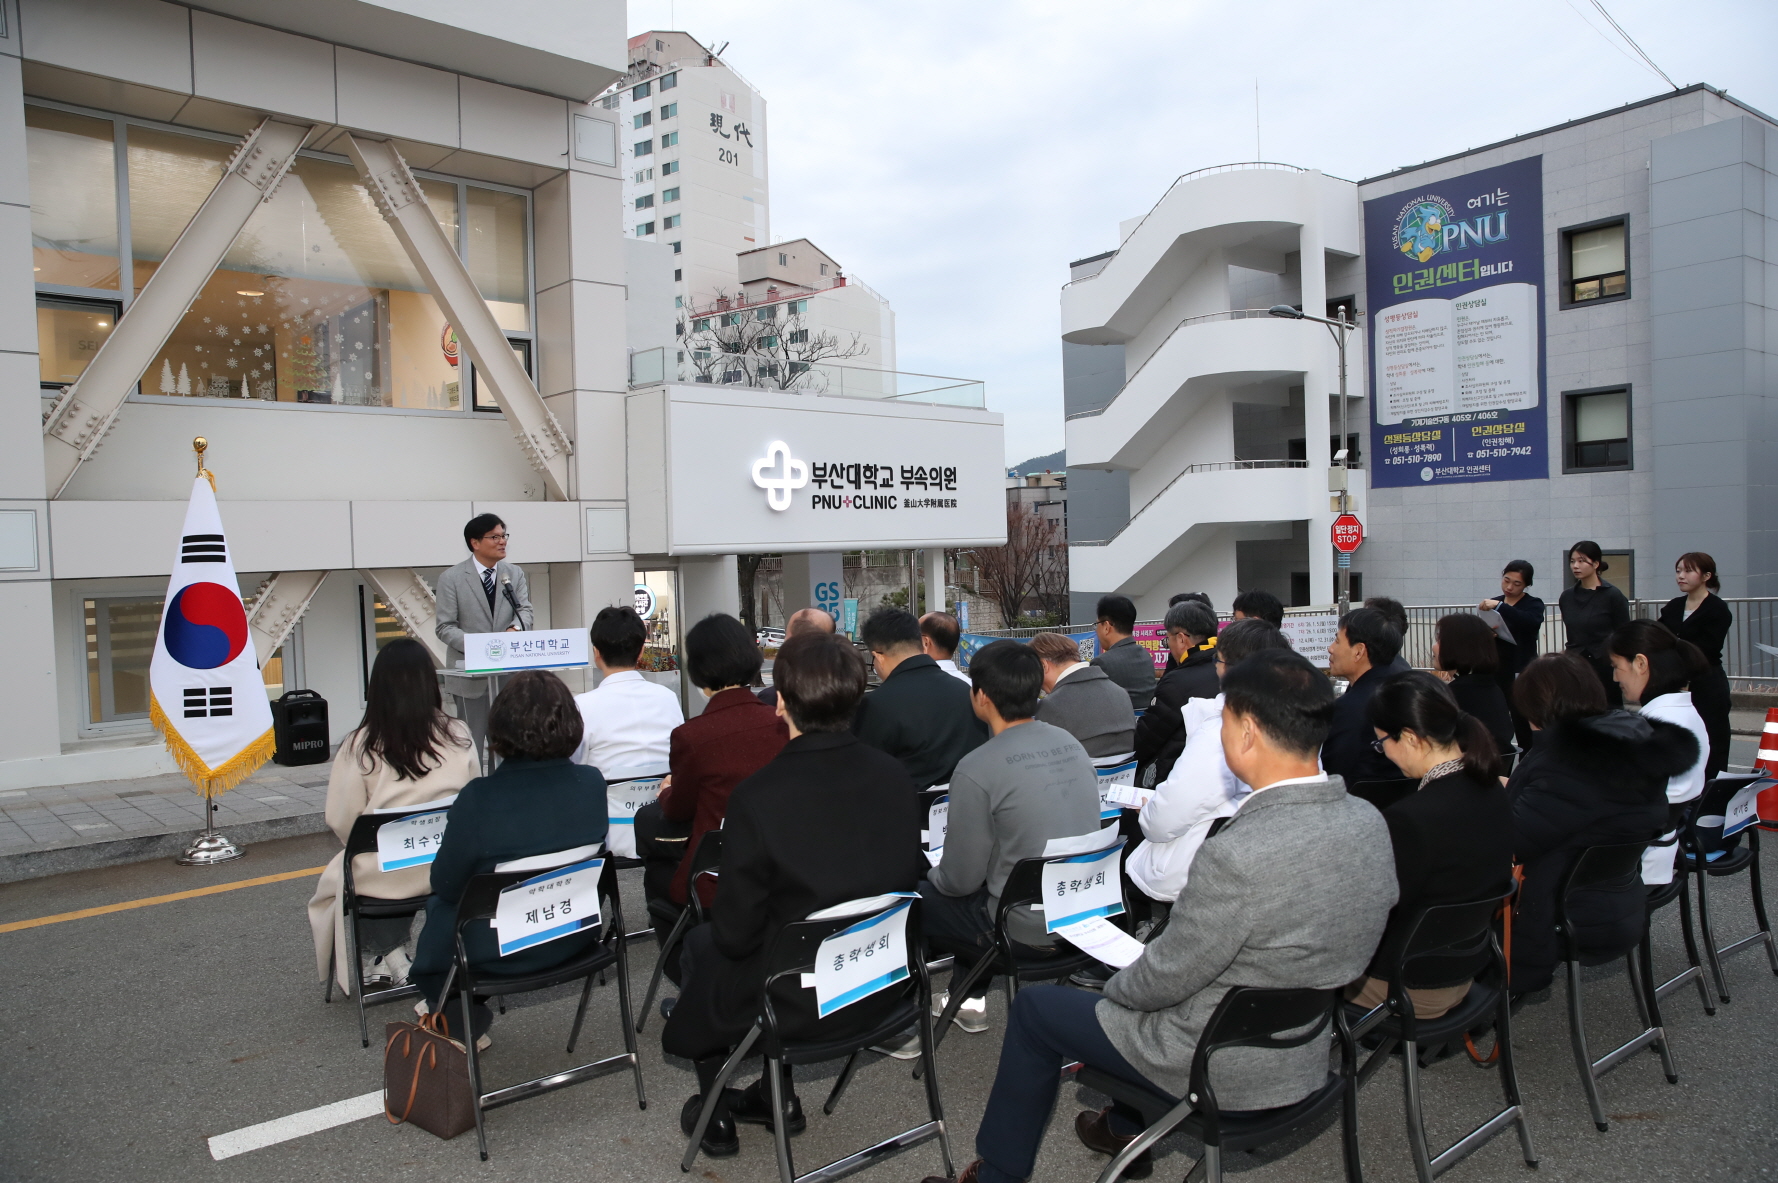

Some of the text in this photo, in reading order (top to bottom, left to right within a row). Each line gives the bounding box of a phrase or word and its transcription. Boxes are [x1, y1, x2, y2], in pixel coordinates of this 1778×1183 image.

[719, 148, 738, 166] 201
[1467, 188, 1510, 208] 여기는
[1396, 196, 1425, 222] NATIONAL
[1427, 194, 1455, 217] UNIVERSITY
[1441, 210, 1509, 253] PNU
[1456, 298, 1487, 310] 인권상담실
[1384, 311, 1418, 323] 성평등상담실
[1452, 412, 1472, 422] 405호
[1478, 411, 1498, 420] 406호
[1472, 422, 1525, 437] 인권상담실
[1384, 430, 1441, 444] 성평등상담실
[1482, 437, 1515, 447] (인권침해)
[1393, 453, 1442, 465] 051-510-7890
[1476, 446, 1531, 459] 051-510-7942
[811, 462, 957, 491] 부산대학교 부속의원
[1435, 464, 1491, 476] 부산대학교 인권센터
[1335, 525, 1358, 534] 일단정지
[1337, 535, 1357, 543] STOP
[815, 582, 840, 601] GS
[510, 638, 569, 653] 부산대학교
[293, 740, 324, 750] MIPRO
[1006, 751, 1035, 764] BORN
[1050, 747, 1063, 756] BE
[411, 816, 441, 825] 학생회장
[1057, 871, 1105, 896] 총학생회
[525, 898, 572, 923] 제남경
[833, 933, 889, 971] 총학생회
